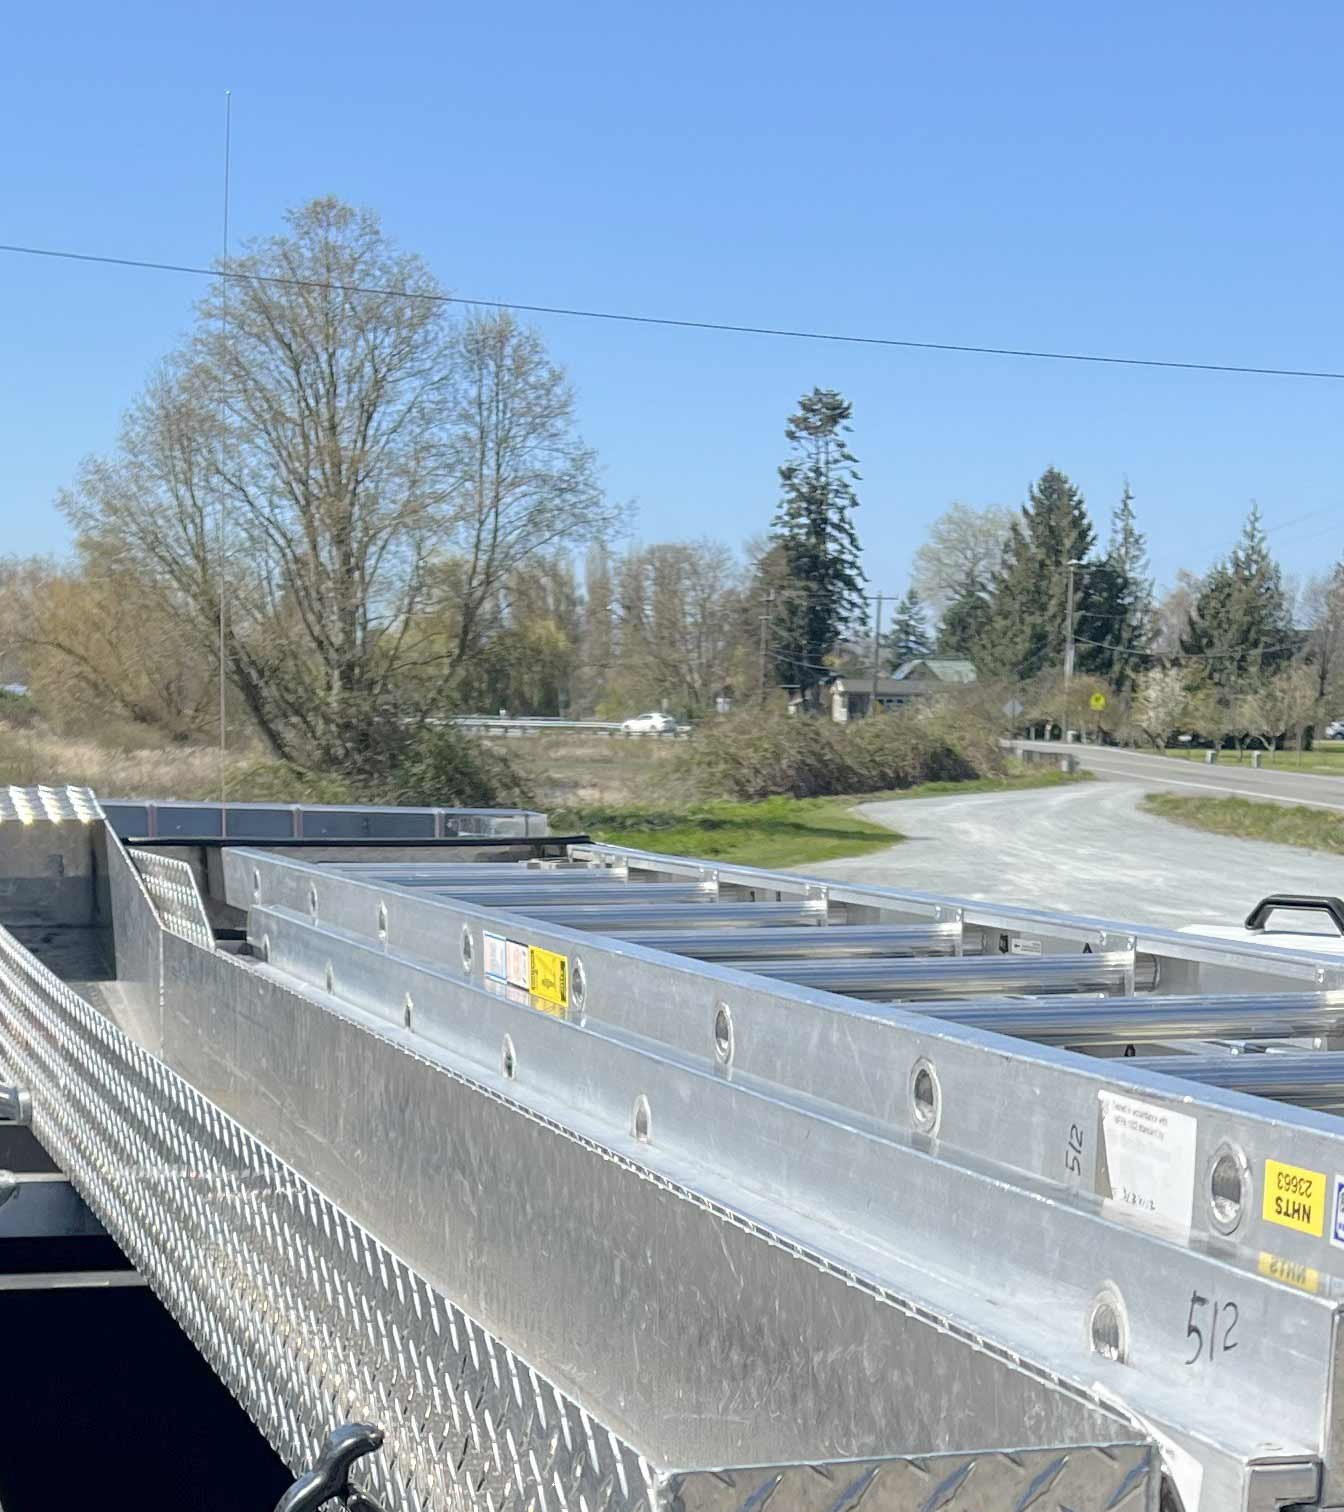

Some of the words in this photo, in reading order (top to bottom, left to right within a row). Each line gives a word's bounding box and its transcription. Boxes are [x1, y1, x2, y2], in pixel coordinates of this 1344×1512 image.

[1065, 1123, 1083, 1177] 512
[1277, 1172, 1313, 1198] 23663
[1274, 1196, 1311, 1224] NHTS
[1184, 1290, 1239, 1366] 512
